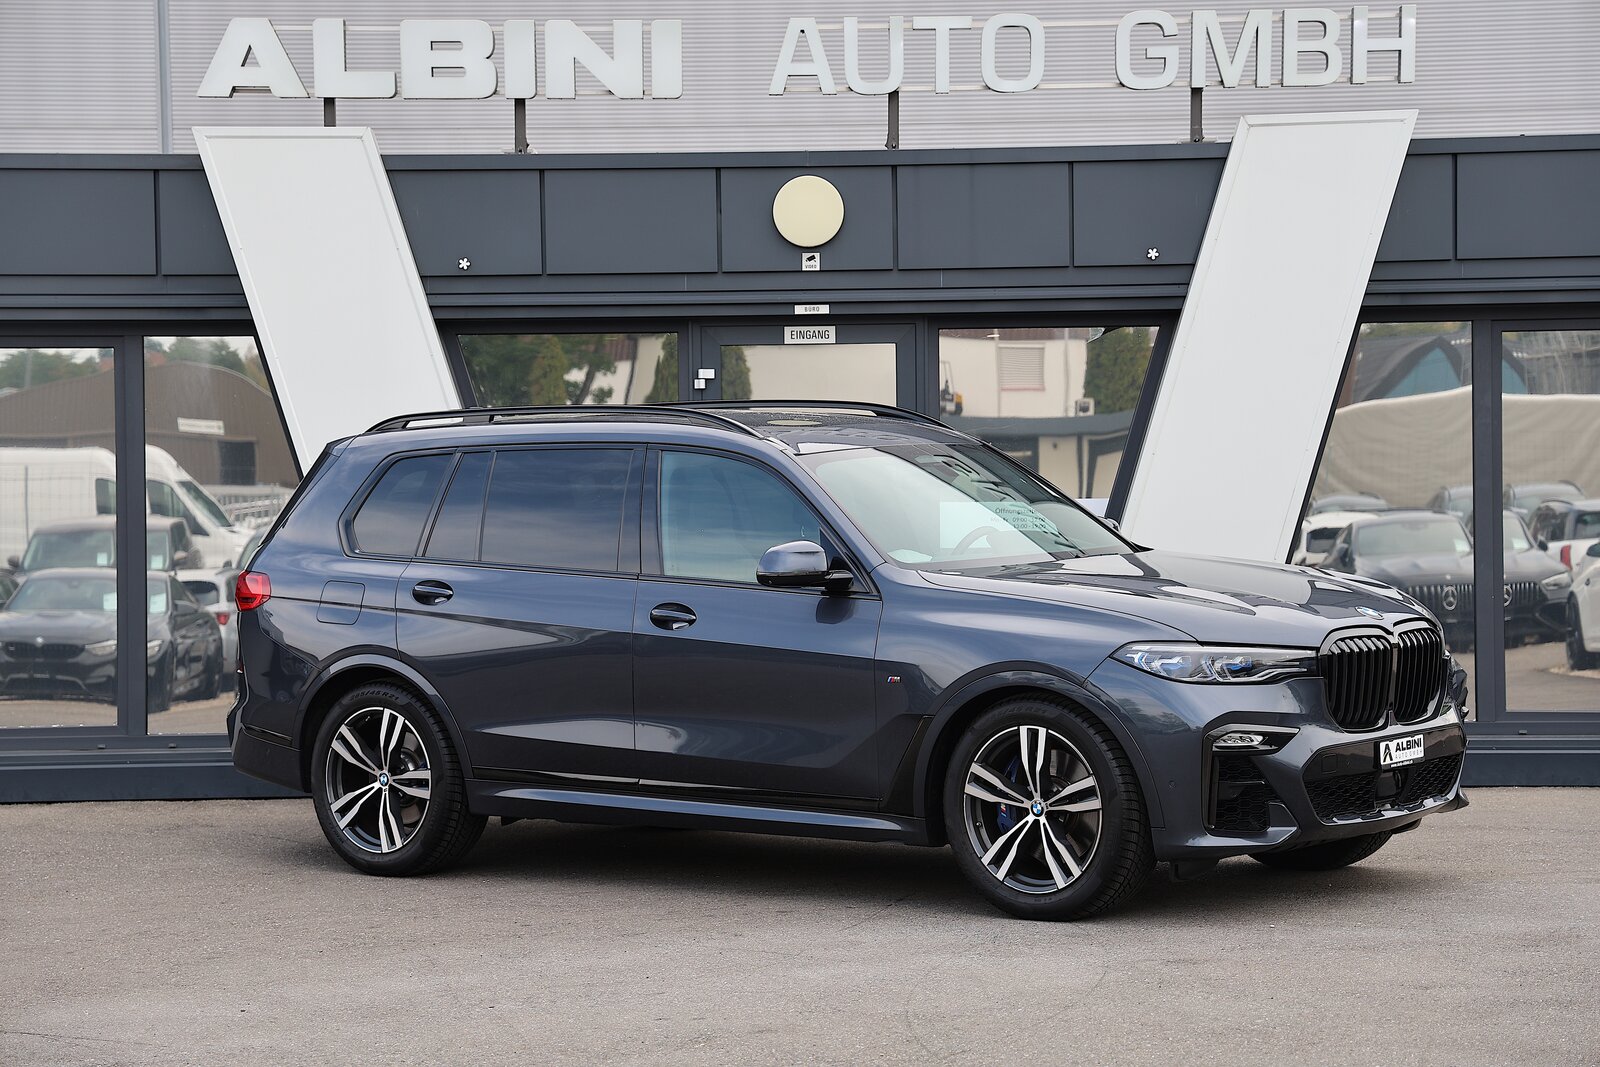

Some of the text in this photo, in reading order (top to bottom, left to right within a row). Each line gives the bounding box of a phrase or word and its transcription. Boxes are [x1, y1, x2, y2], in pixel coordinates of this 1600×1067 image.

[197, 5, 1417, 99] ALBINI AUTO GMBH
[790, 329, 830, 340] EINGANG
[1395, 737, 1422, 752] ALBINI
